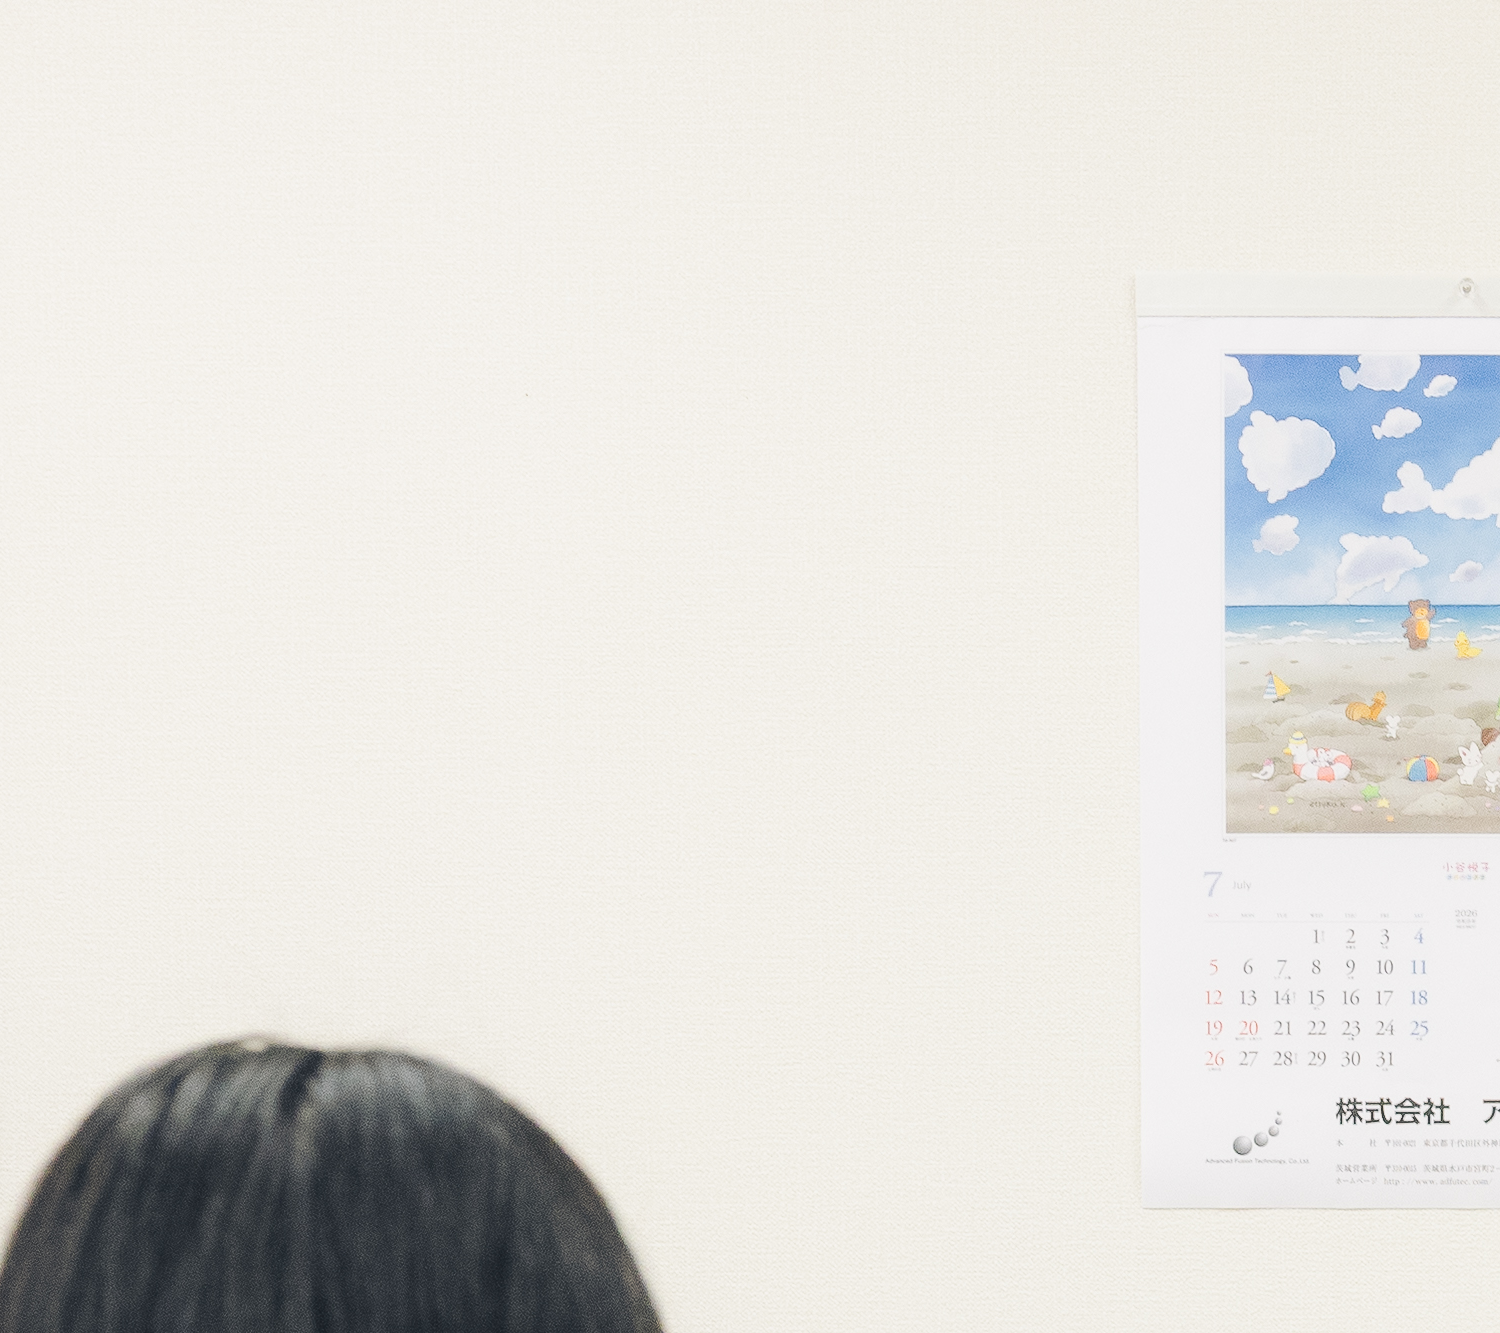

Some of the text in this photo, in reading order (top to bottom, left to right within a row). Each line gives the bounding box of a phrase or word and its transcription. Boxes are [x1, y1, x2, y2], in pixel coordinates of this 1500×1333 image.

[1203, 871, 1251, 898] 7 July
[1312, 929, 1424, 945] 1 2 3 4
[1209, 960, 1427, 975] 5 6 7 8 9 10 11
[1206, 990, 1428, 1006] 12 13 14 15 16 17 18
[1206, 1021, 1429, 1037] 19 20 21 22 23 24 25
[1205, 1051, 1394, 1068] 26 27 28 29 30 31
[1336, 1097, 1451, 1126] 株式会社
